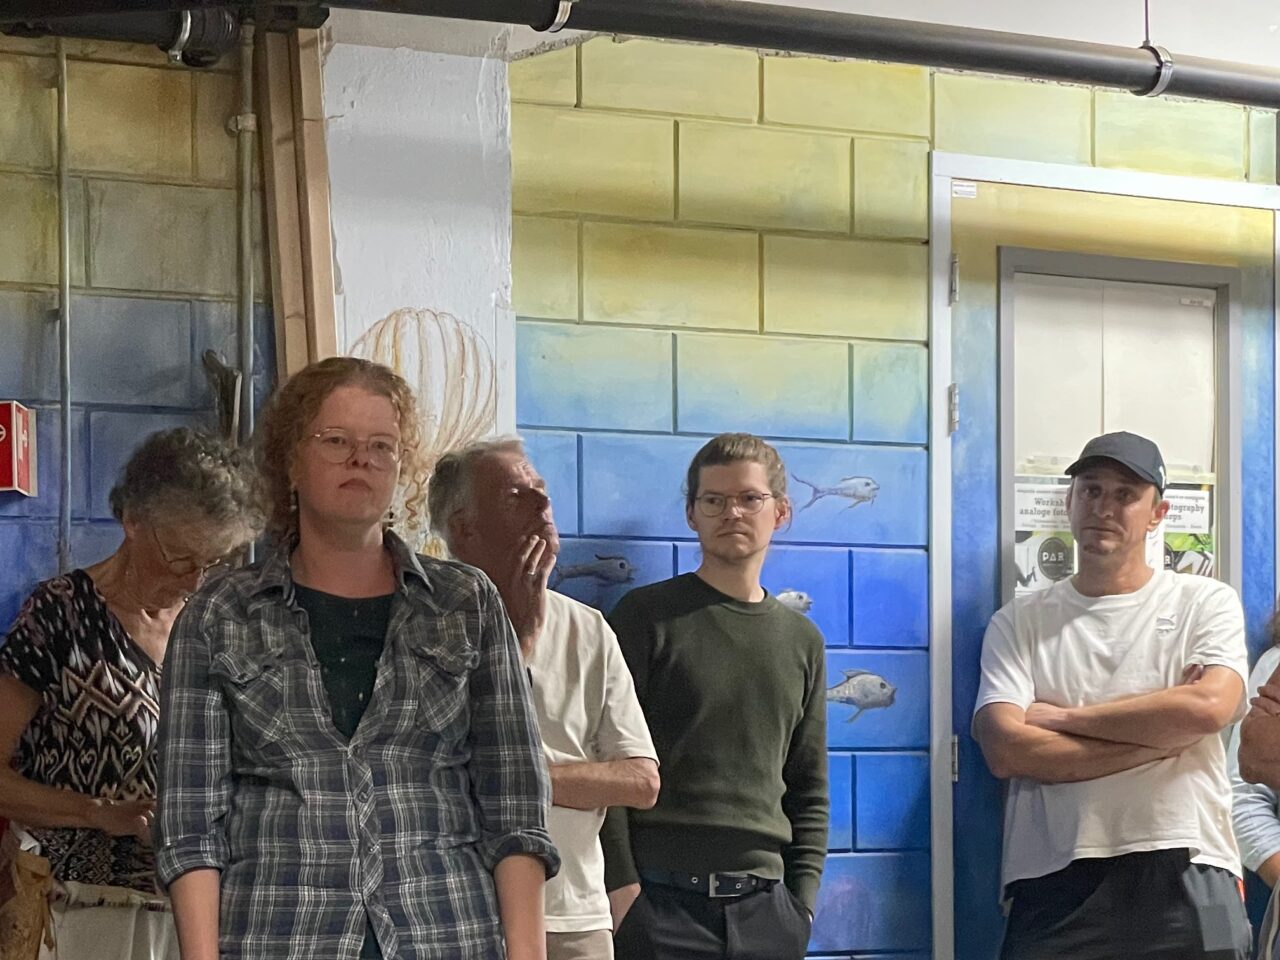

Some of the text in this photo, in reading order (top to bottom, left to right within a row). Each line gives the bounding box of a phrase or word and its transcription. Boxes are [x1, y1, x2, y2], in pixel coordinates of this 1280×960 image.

[1034, 497, 1065, 506] Worksh
[1053, 508, 1071, 516] foto
[1169, 503, 1205, 514] tography
